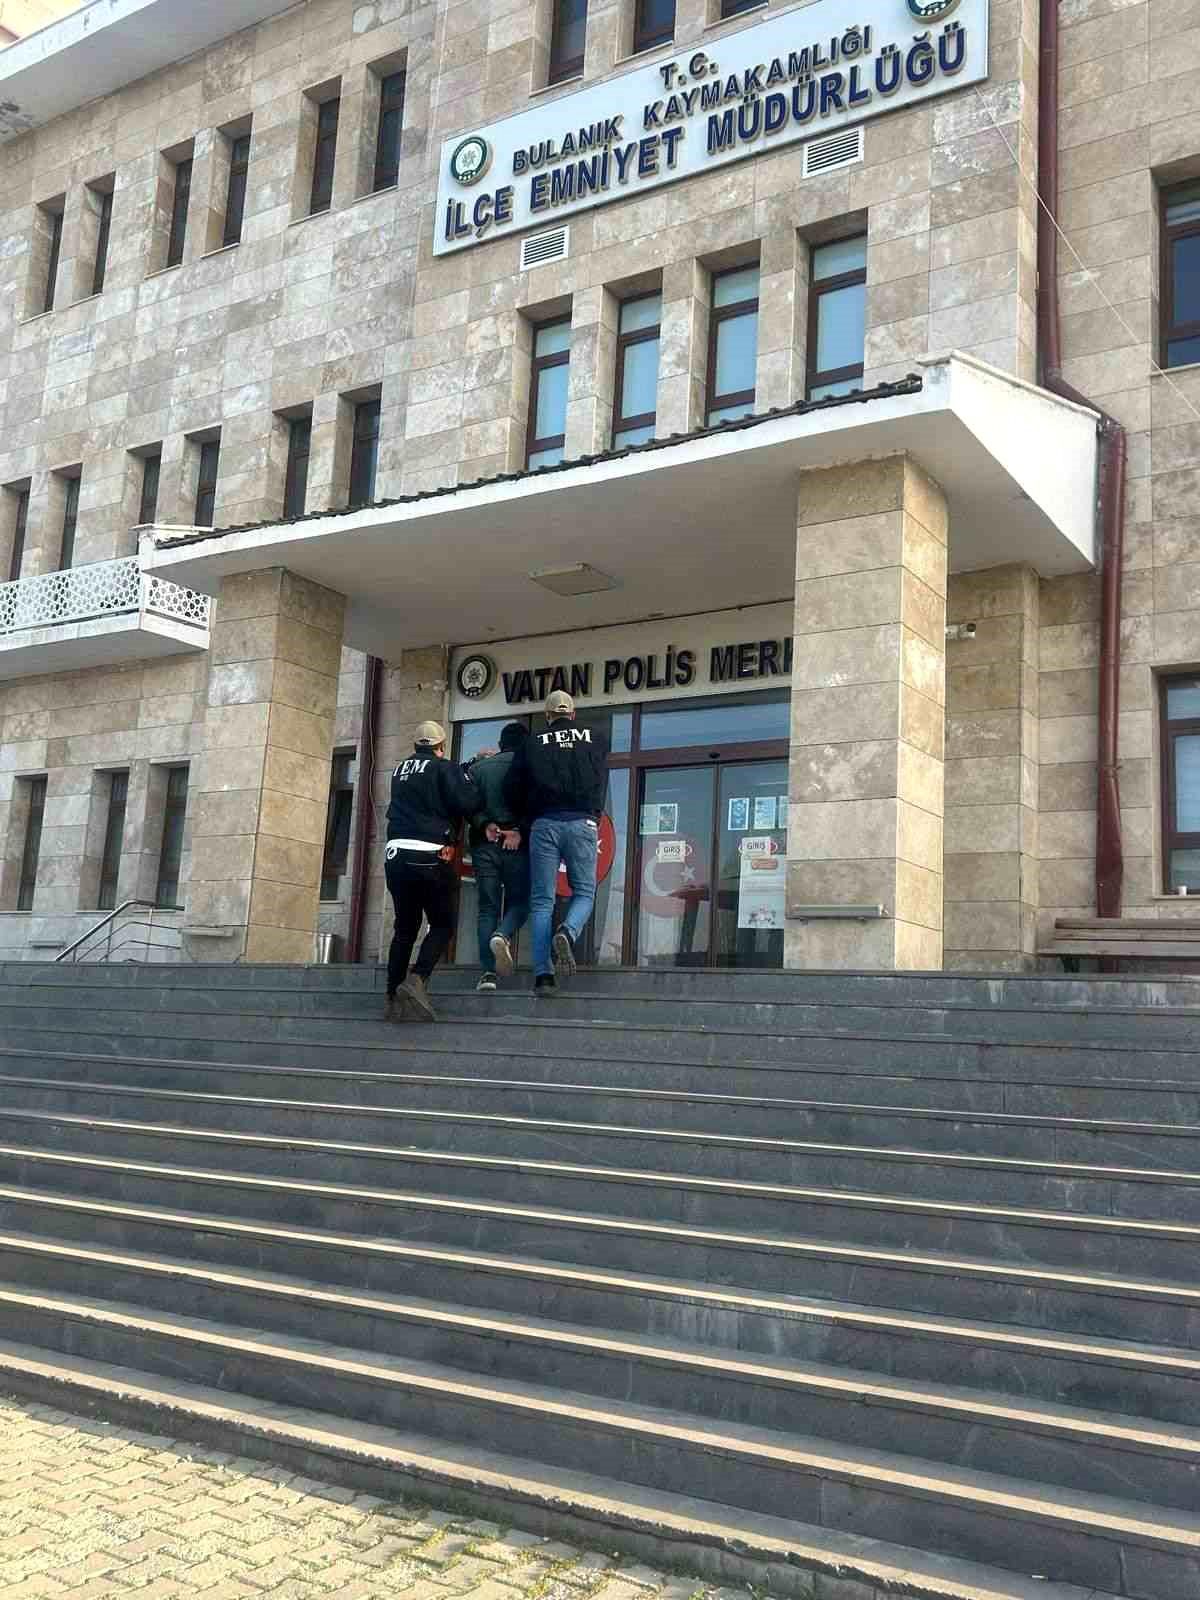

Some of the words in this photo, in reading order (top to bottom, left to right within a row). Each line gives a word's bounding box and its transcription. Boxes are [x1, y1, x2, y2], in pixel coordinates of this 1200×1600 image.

[512, 113, 624, 176] BULANIK
[643, 24, 873, 129] KAYMAKAMLIĞI
[660, 51, 719, 90] T.C.
[445, 185, 514, 241] İLÇE
[530, 125, 685, 213] EMNİYET
[706, 21, 968, 155] MÜDÜRLÜĞÜ
[502, 661, 593, 705] VATAN
[603, 645, 697, 694] POLİS
[536, 728, 592, 745] TEM
